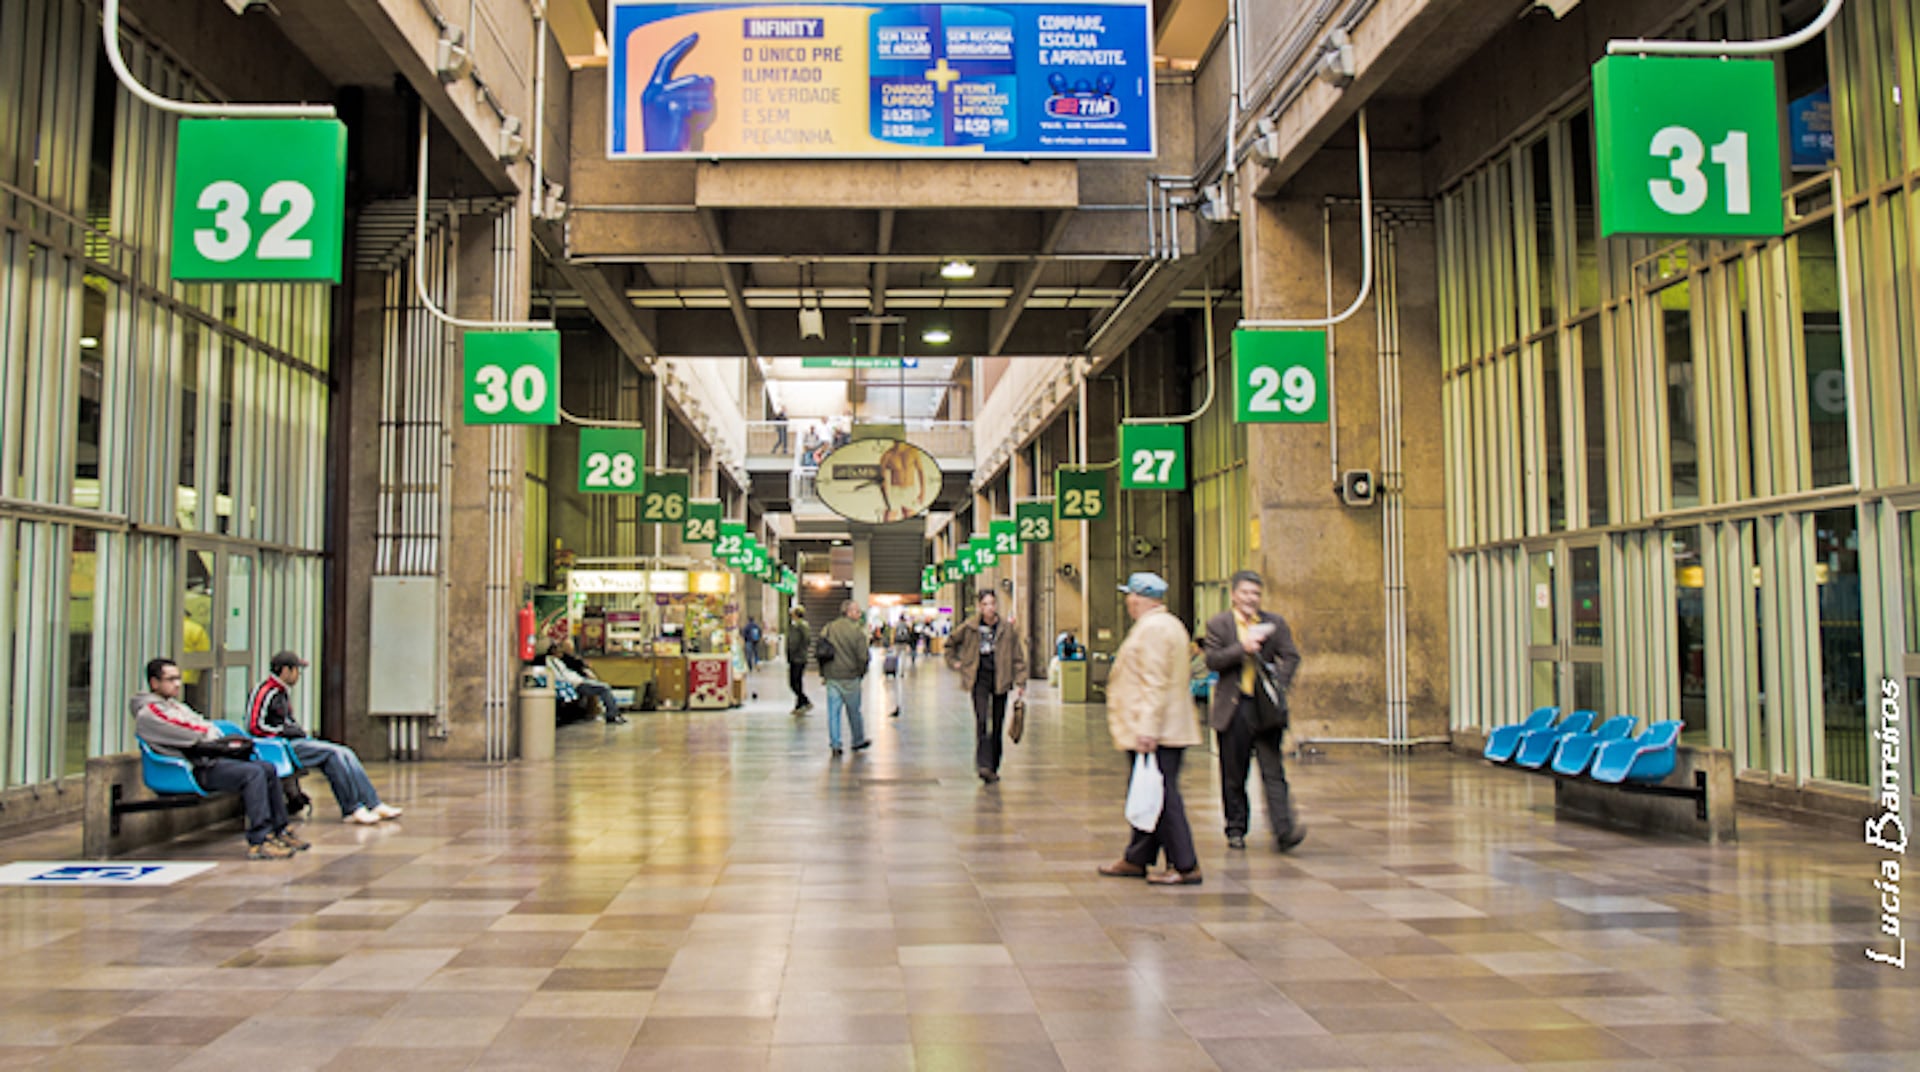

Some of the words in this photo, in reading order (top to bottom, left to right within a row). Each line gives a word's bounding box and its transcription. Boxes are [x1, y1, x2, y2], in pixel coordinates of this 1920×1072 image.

[750, 20, 817, 37] INFINITY
[1038, 15, 1105, 33] COMPARE,
[1039, 32, 1098, 47] ESCOLHA
[743, 48, 753, 62] O
[759, 45, 806, 62] ÚNICO
[812, 45, 843, 62] PRÉ
[1039, 50, 1049, 65] E
[1050, 50, 1127, 65] APROVEITE.
[743, 67, 822, 83] ILIMITADO
[743, 88, 763, 104] DE
[768, 88, 841, 104] VERDADE
[743, 109, 750, 124] E
[757, 109, 789, 124] SEM
[1079, 99, 1111, 115] TIM
[1647, 126, 1751, 215] 31
[193, 180, 315, 262] 32
[473, 365, 548, 414] 30
[1248, 365, 1316, 414] 29
[585, 452, 636, 487] 28
[1132, 449, 1176, 482] 27
[645, 493, 684, 520] 26
[1064, 489, 1102, 516] 25
[686, 519, 717, 540] 24
[1020, 517, 1050, 540] 23
[716, 535, 743, 554] 22
[996, 533, 1017, 551] 21
